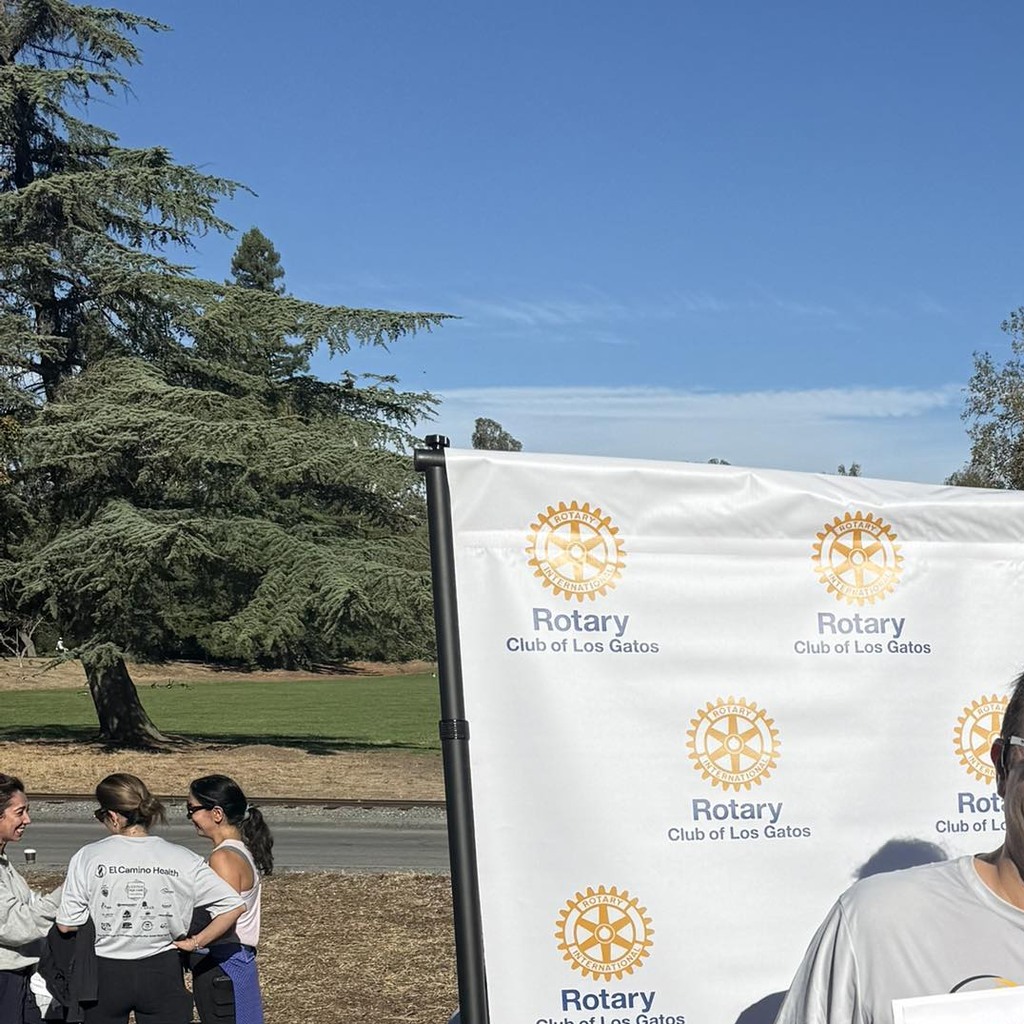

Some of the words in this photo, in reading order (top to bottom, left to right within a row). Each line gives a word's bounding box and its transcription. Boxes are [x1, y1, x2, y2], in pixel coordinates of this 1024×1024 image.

[554, 512, 596, 524] ROTARY
[839, 521, 876, 532] ROTARY
[543, 566, 615, 592] INTERNATIONAL
[532, 607, 630, 637] Rotary
[817, 612, 905, 639] Rotary
[506, 637, 547, 652] Club
[551, 638, 568, 652] of
[573, 638, 604, 653] Los
[609, 639, 660, 654] Gatos
[794, 640, 830, 654] Club
[835, 641, 850, 654] of
[854, 640, 883, 654] Los
[887, 640, 931, 654] Gatos
[712, 706, 752, 718] ROTARY
[703, 758, 769, 782] INTERNATIONAL
[692, 798, 783, 824] Rotary
[957, 792, 1005, 814] Rot
[668, 827, 705, 841] Club
[709, 827, 725, 840] of
[730, 826, 759, 839] Los
[764, 825, 811, 838] Gatos
[935, 820, 969, 833] Club
[973, 819, 987, 832] of
[109, 866, 117, 874] El
[118, 865, 151, 874] Camino
[153, 867, 179, 877] Health
[582, 896, 623, 908] ROTARY
[572, 946, 641, 972] INTERNATIONAL
[561, 989, 655, 1012] Rotary
